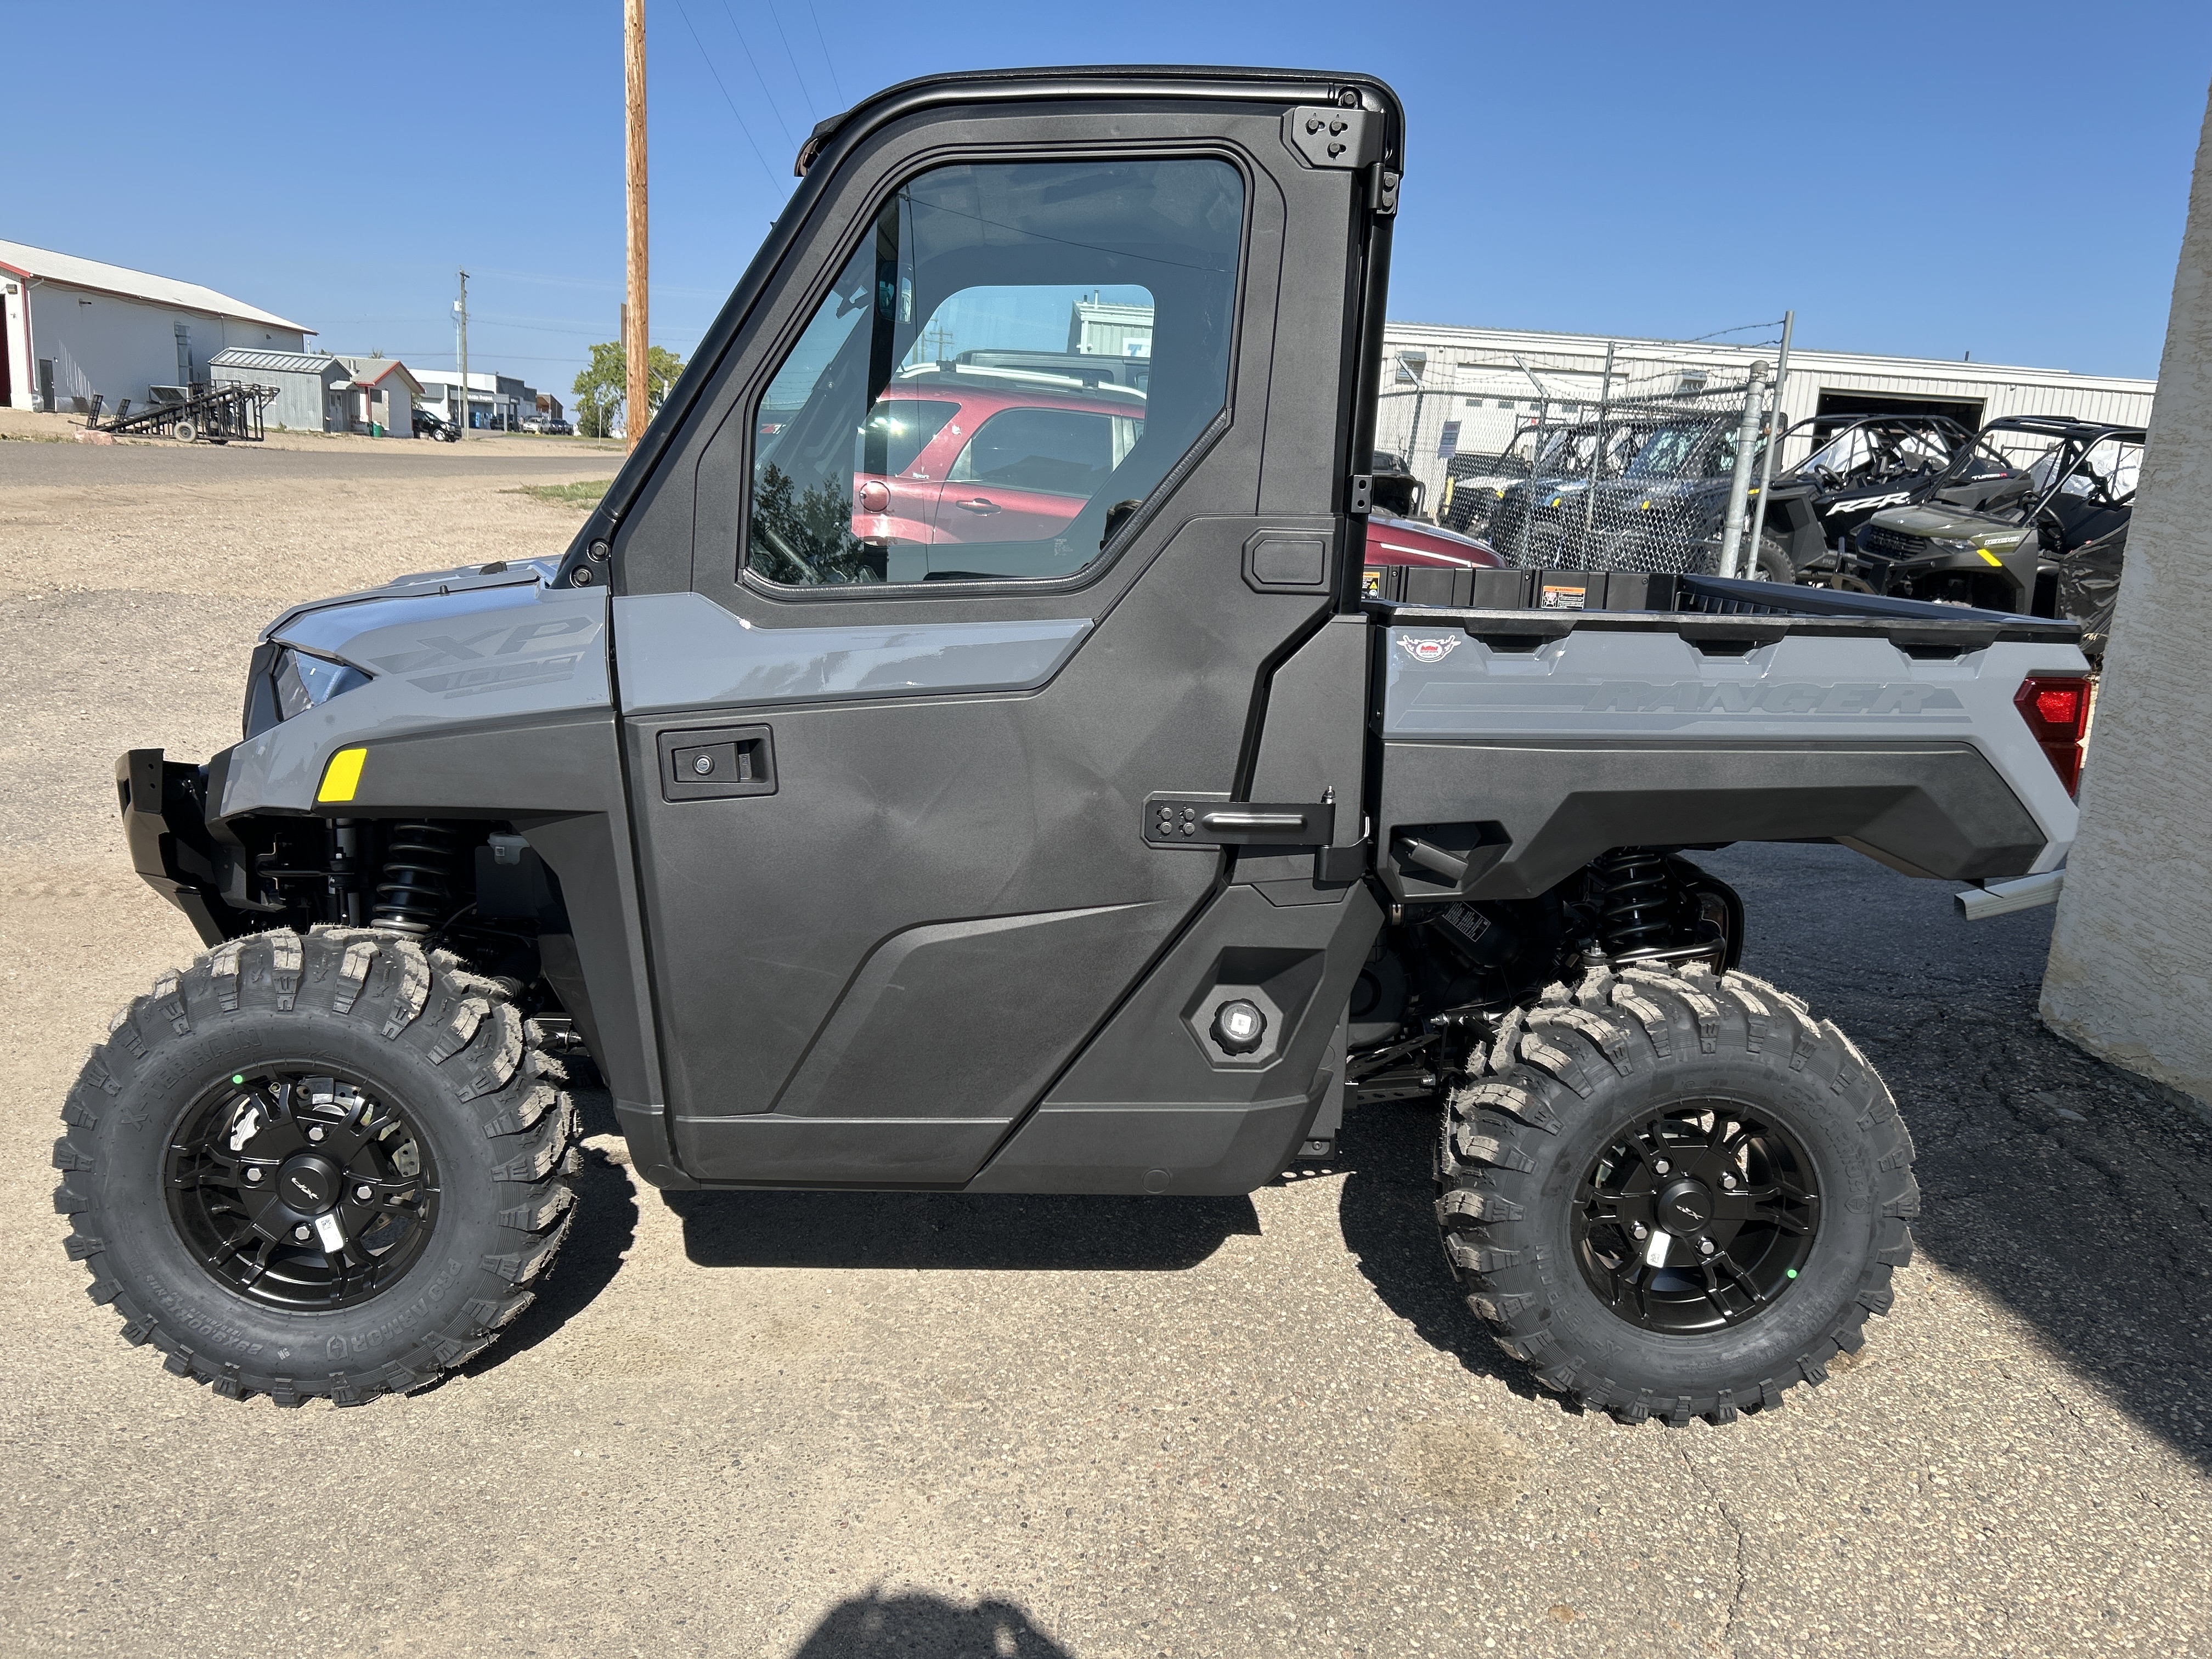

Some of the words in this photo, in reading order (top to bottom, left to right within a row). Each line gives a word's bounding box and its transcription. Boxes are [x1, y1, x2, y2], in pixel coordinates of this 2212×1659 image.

[1825, 492, 1910, 516] RZR
[406, 616, 594, 673] XP
[1582, 680, 1936, 714] RANGER
[428, 1257, 463, 1302] PRO
[351, 1297, 430, 1352] ARMOR
